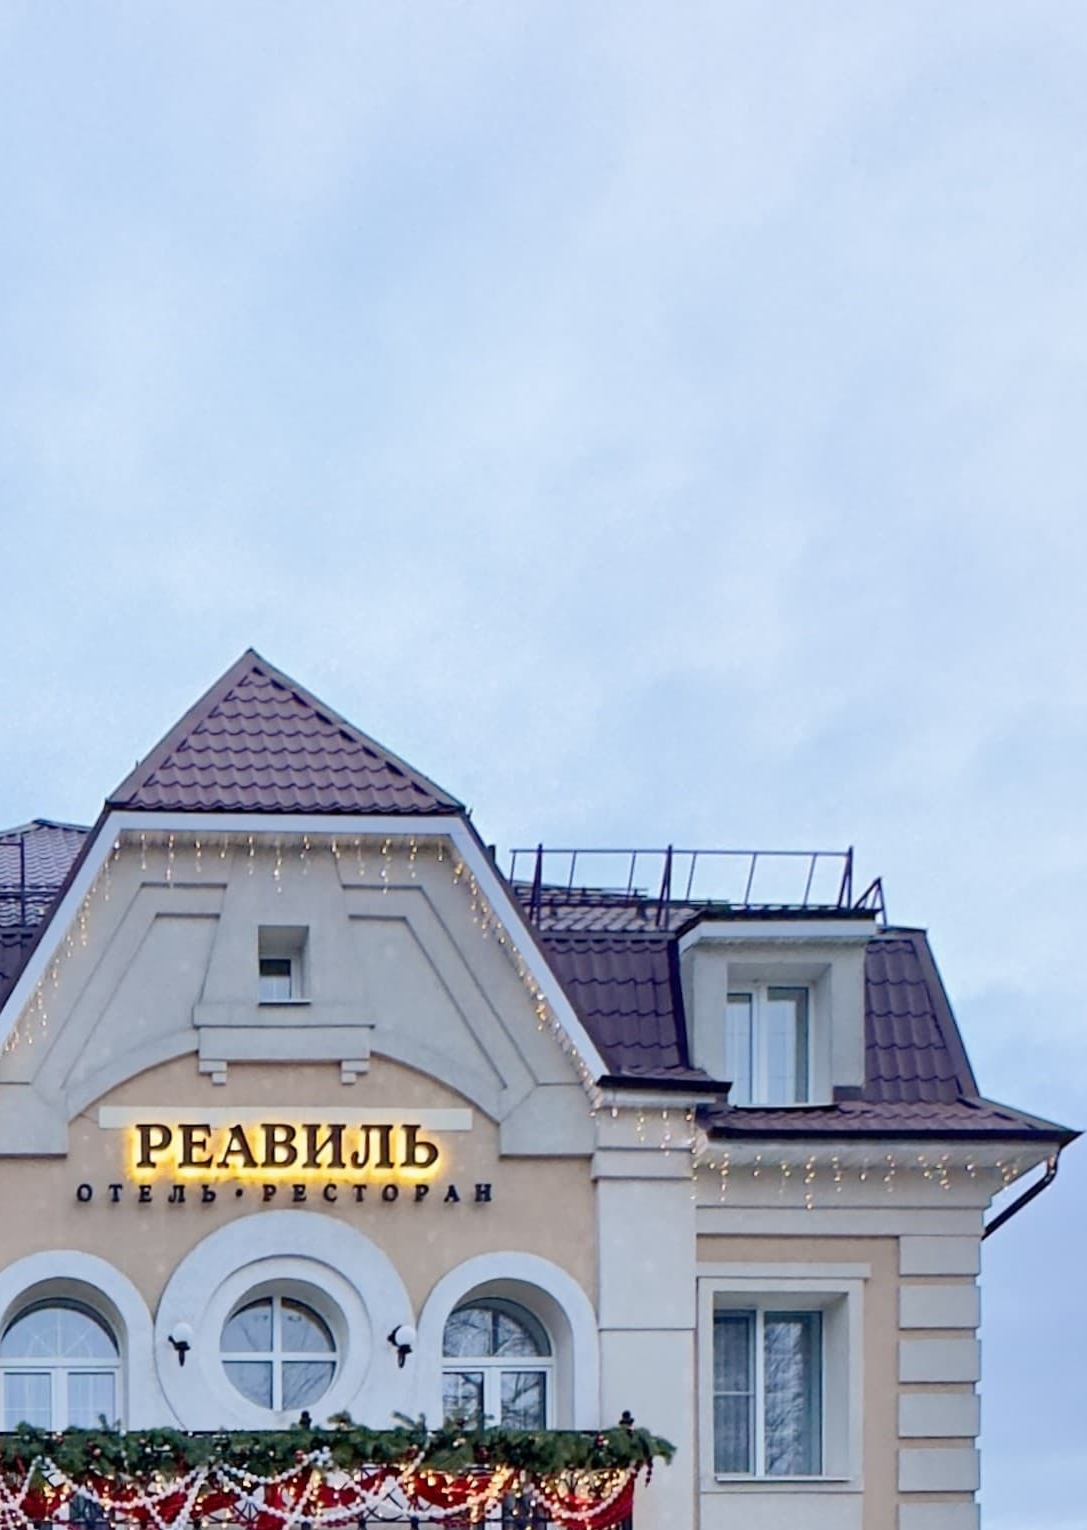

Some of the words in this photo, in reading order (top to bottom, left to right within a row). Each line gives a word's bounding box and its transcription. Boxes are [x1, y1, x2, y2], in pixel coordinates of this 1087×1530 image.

[135, 1123, 439, 1169] РЕАВИЛЬ
[76, 1183, 217, 1203] ОТЕЛЬ
[261, 1183, 493, 1203] РЕСТОРАН
